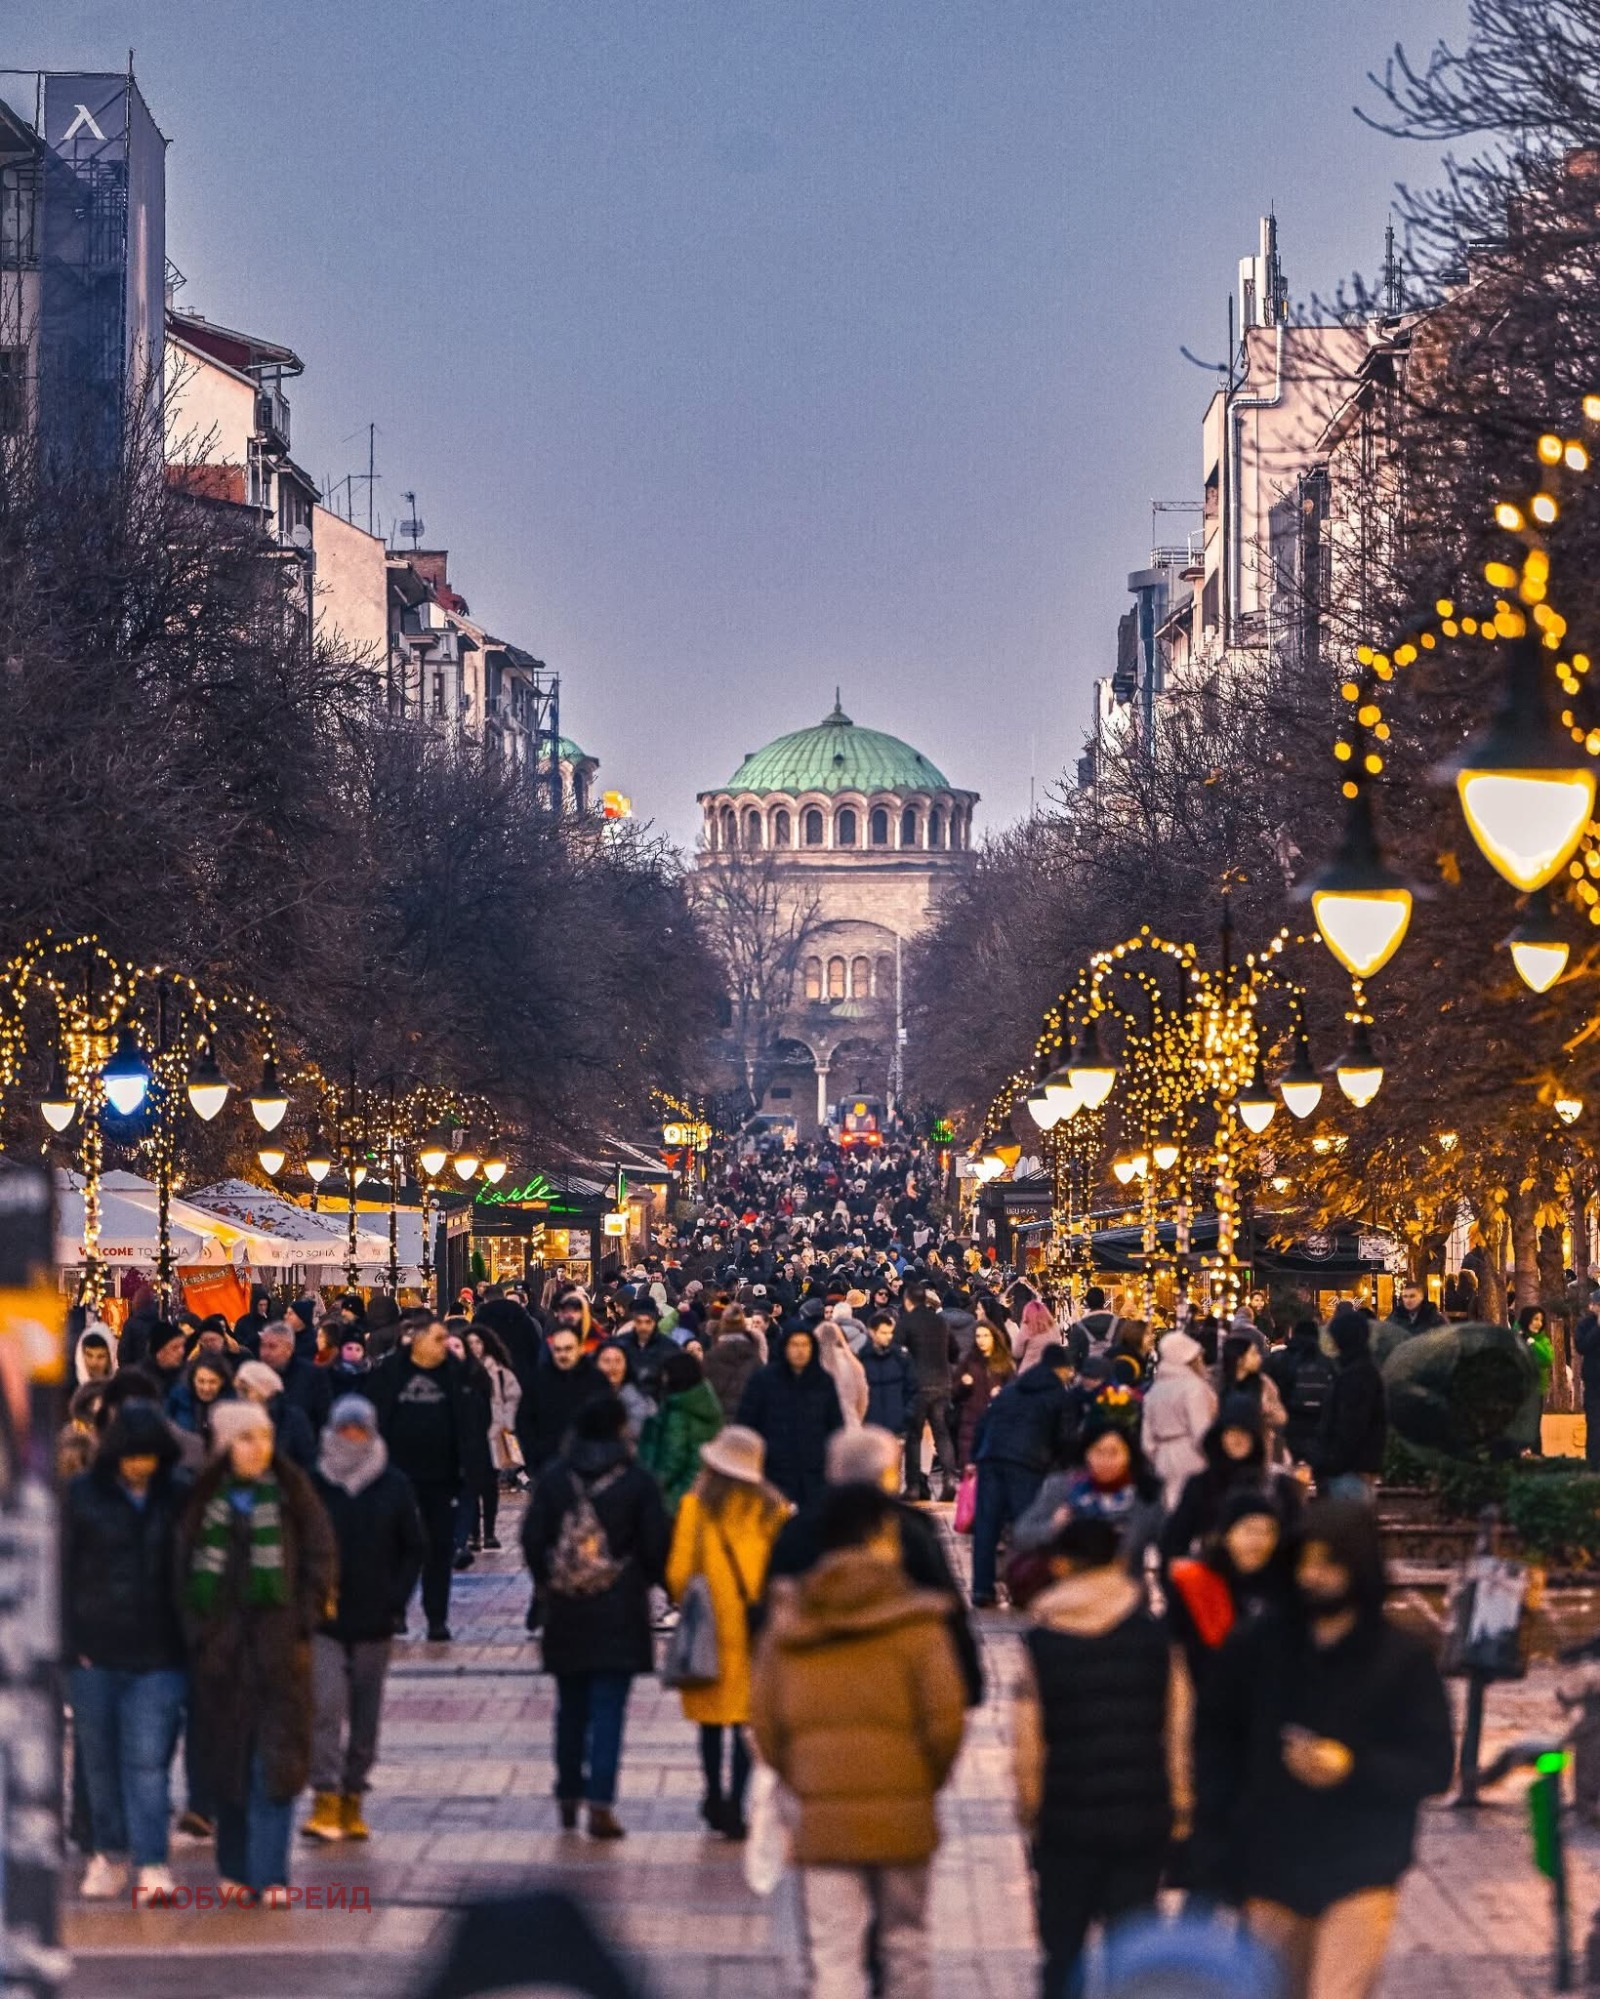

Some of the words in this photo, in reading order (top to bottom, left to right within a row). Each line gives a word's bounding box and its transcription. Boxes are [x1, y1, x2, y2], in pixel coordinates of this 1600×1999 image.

[78, 1246, 134, 1256] WLCOME
[137, 1247, 153, 1256] TO
[155, 1247, 190, 1257] SIA
